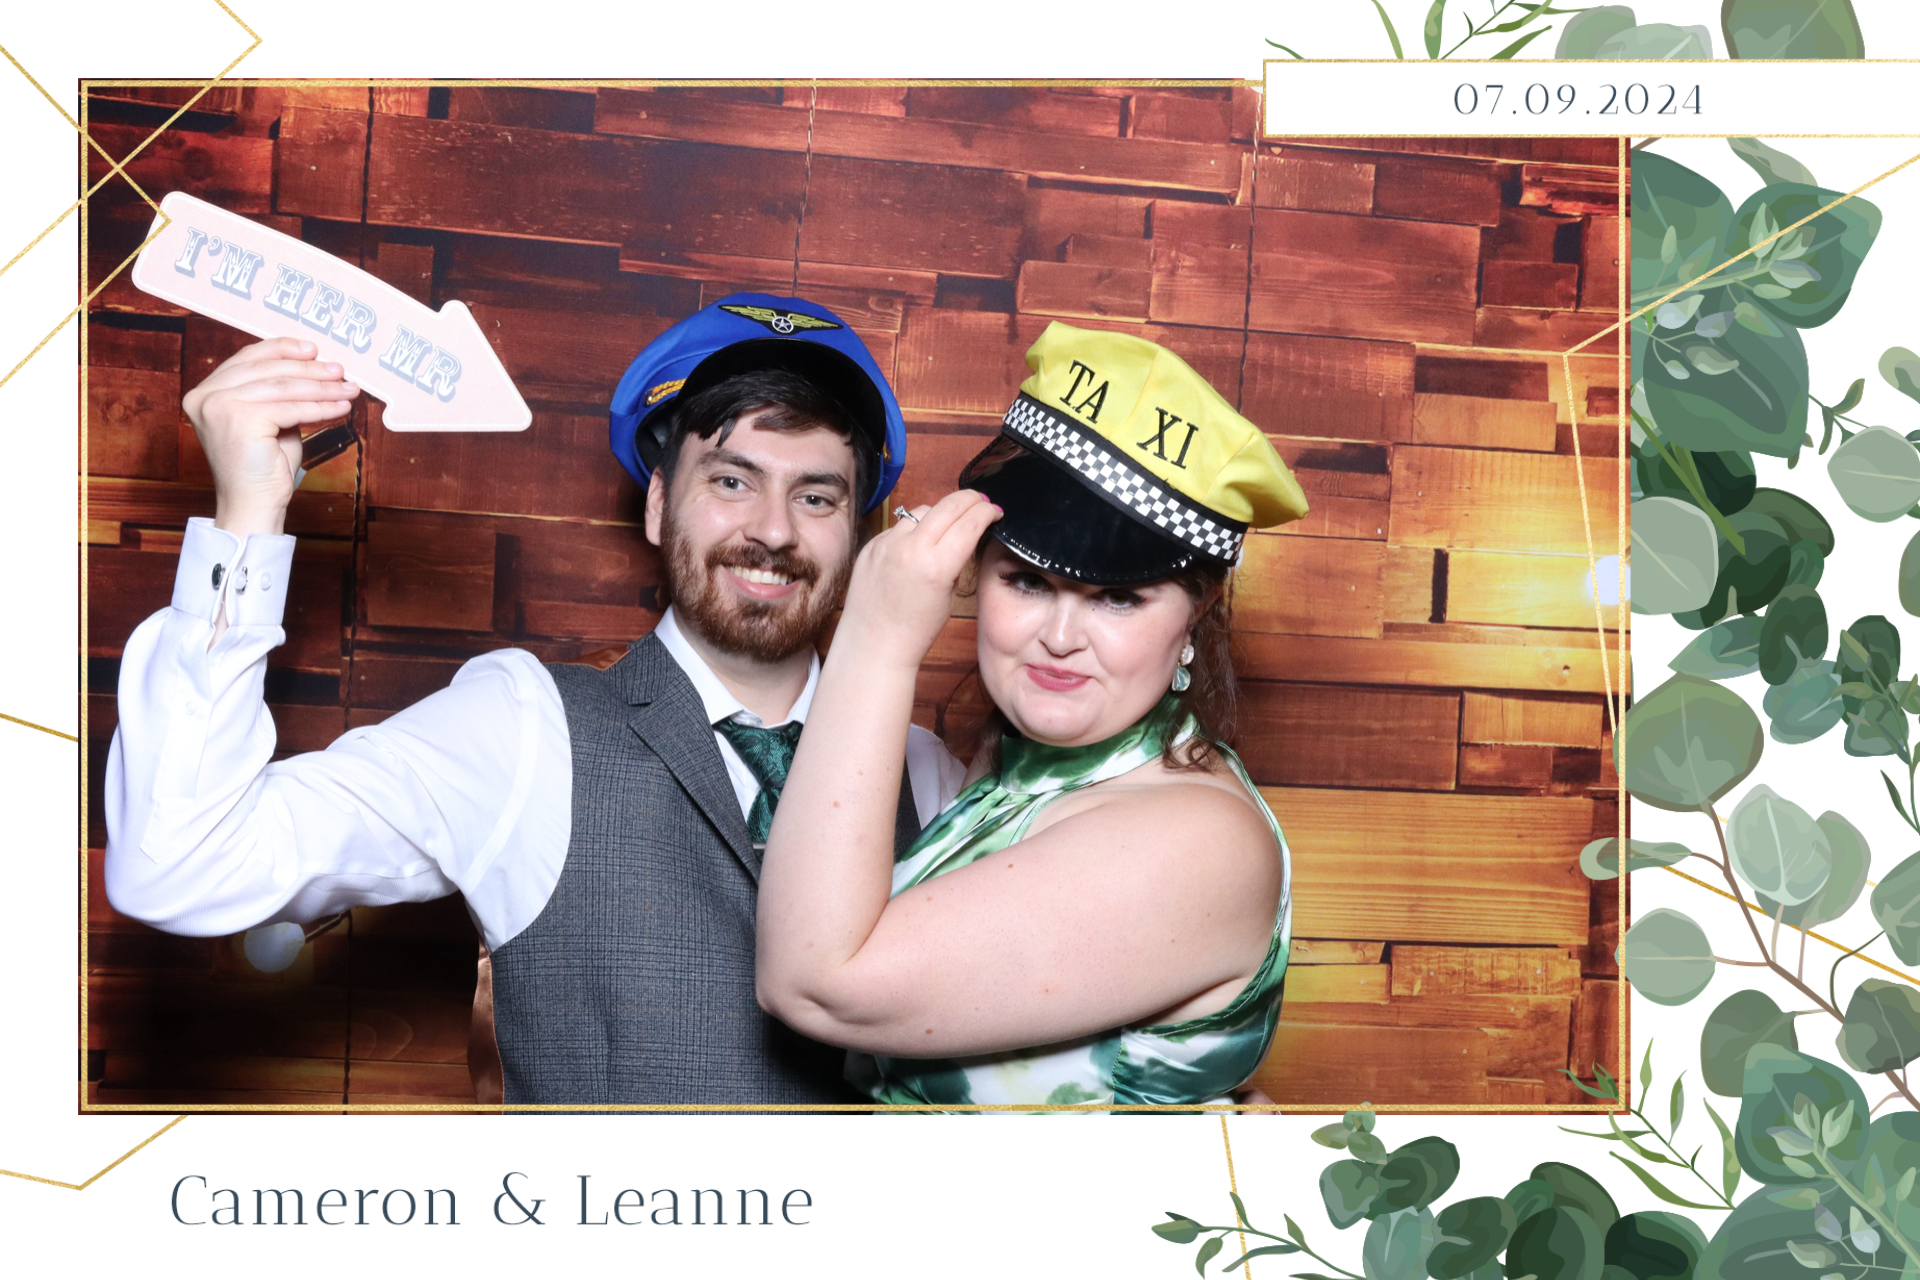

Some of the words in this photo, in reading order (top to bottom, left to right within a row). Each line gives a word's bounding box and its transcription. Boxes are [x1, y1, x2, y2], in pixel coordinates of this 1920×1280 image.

[174, 227, 264, 299] I'M
[263, 263, 378, 354] HER
[379, 323, 463, 403] MR
